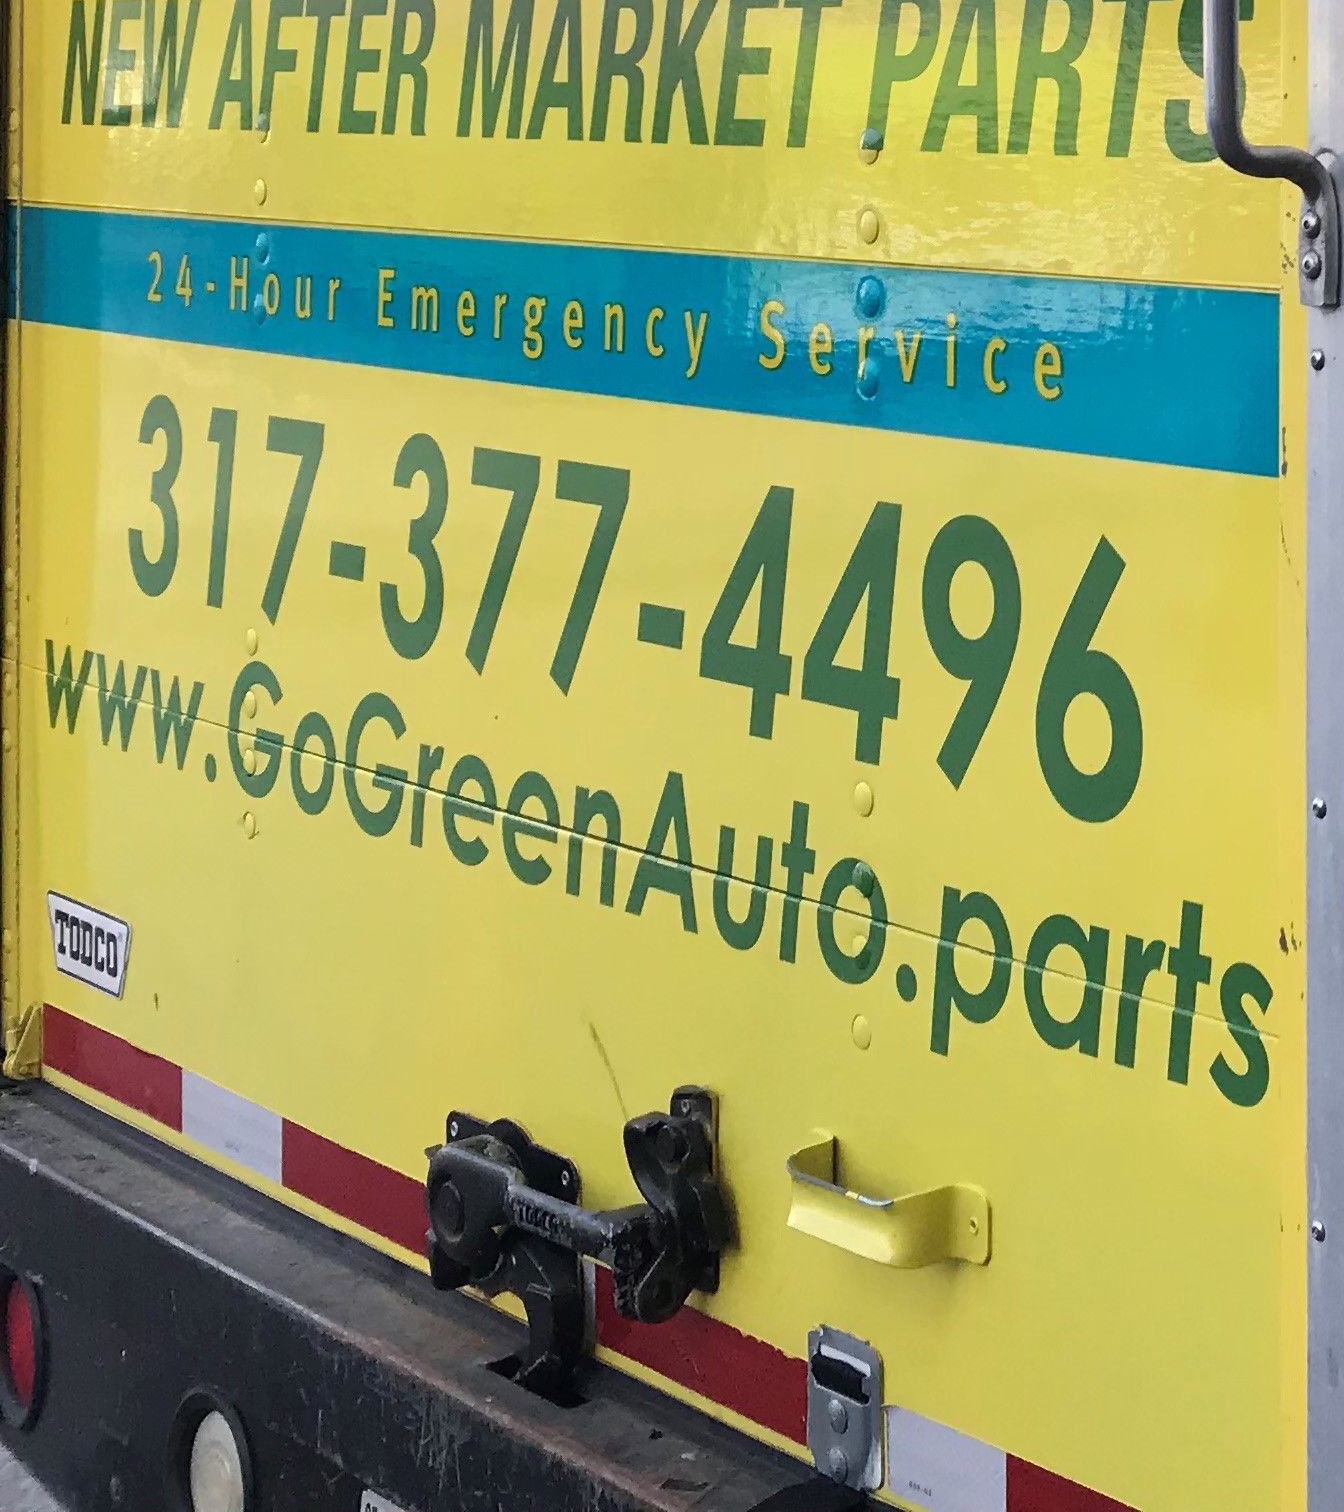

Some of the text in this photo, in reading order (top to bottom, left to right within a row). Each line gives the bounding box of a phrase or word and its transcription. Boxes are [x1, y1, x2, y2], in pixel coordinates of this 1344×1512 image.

[147, 251, 1065, 401] 24-Hour Emergency Service
[128, 394, 1144, 824] 317-377-4496
[45, 639, 1274, 1108] www.GoGreenAuto.parts
[55, 909, 117, 978] TODCO
